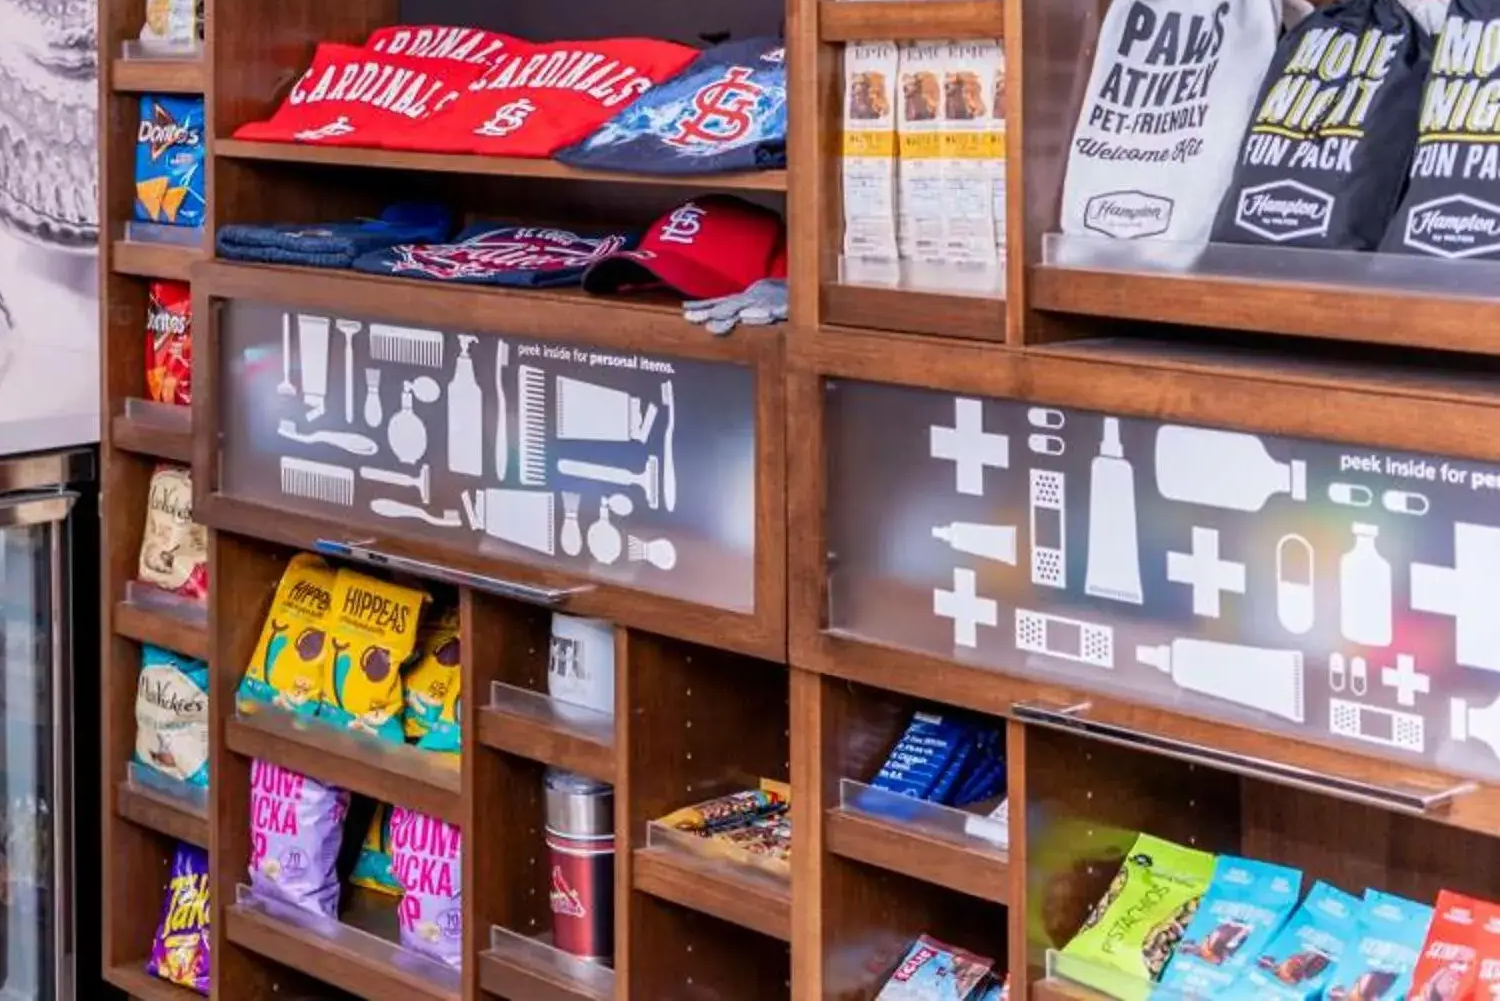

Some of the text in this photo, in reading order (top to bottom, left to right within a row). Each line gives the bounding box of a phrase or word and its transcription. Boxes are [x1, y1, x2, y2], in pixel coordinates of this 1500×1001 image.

[1117, 0, 1230, 59] PAWS
[138, 118, 199, 146] Doritos
[1089, 103, 1210, 136] PET-FRIENDLY
[1075, 136, 1173, 163] Welcome
[1243, 135, 1359, 173] FUN PACK
[1410, 144, 1459, 179] FUN
[1243, 191, 1328, 220] Hampton
[1411, 208, 1500, 236] Hampton
[543, 345, 572, 361] inside
[573, 349, 588, 362] for
[589, 353, 637, 369] personal
[1340, 454, 1382, 474] peek
[1385, 456, 1437, 481] inside
[1440, 463, 1468, 484] for
[342, 586, 410, 635] HIPPEAS
